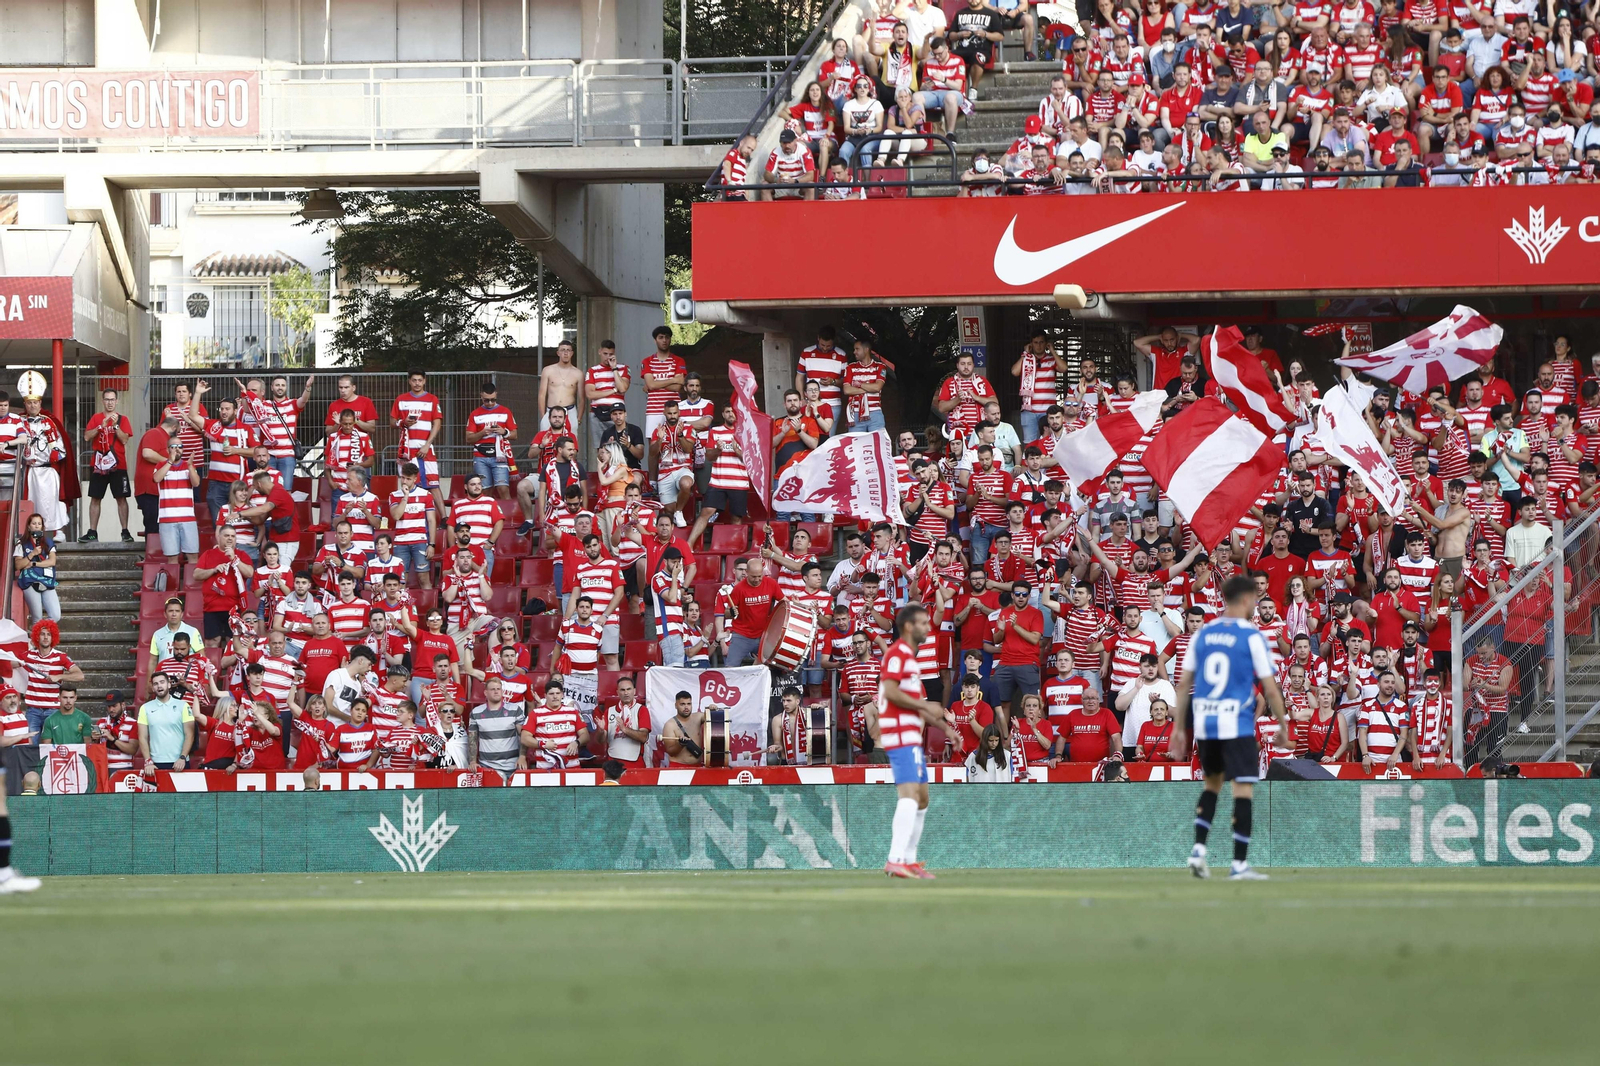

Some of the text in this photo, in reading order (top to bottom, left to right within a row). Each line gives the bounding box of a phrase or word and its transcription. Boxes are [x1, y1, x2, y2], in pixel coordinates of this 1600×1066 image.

[102, 79, 249, 130] CONTIGO
[28, 294, 47, 308] SIN
[779, 477, 799, 500] GCF
[581, 578, 604, 586] Platzi
[1117, 647, 1142, 661] Platzi
[1203, 651, 1230, 700] 9
[704, 679, 737, 701] GCF
[545, 721, 571, 731] Platzi
[614, 791, 859, 870] ANA
[1360, 780, 1595, 863] Fieles
